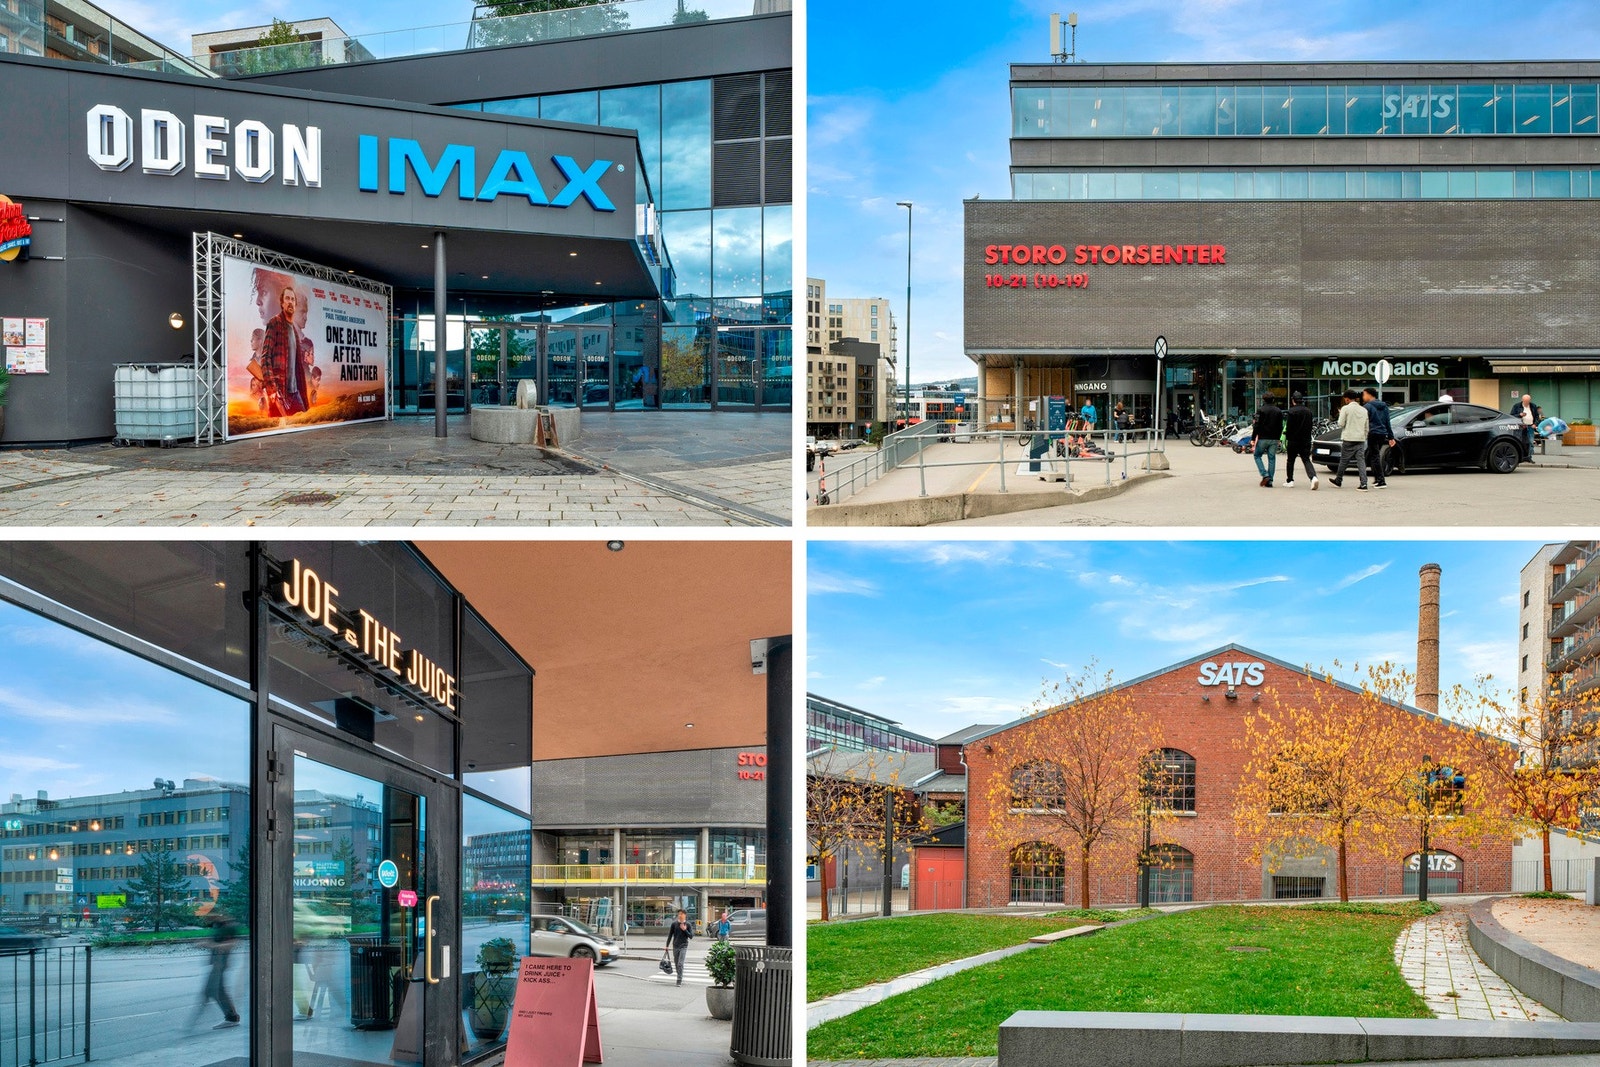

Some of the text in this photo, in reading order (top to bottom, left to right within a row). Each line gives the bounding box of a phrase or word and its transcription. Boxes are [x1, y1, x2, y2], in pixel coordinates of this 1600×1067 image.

[1380, 95, 1455, 118] SATS
[86, 104, 322, 188] ODEON
[359, 134, 616, 212] IMAX
[985, 244, 1226, 265] STORO STORSENTER
[985, 272, 1089, 289] 10-21 (10-19)
[326, 326, 378, 347] ONE BATTLE
[333, 346, 361, 363] AFTER
[340, 365, 378, 381] ANOTHER
[284, 558, 339, 634] JOE
[345, 628, 359, 649] &
[360, 608, 456, 711] THE JUICE
[1197, 662, 1266, 686] SATS
[738, 752, 767, 766] STO
[738, 770, 765, 780] 10-21
[1409, 854, 1458, 870] SATS
